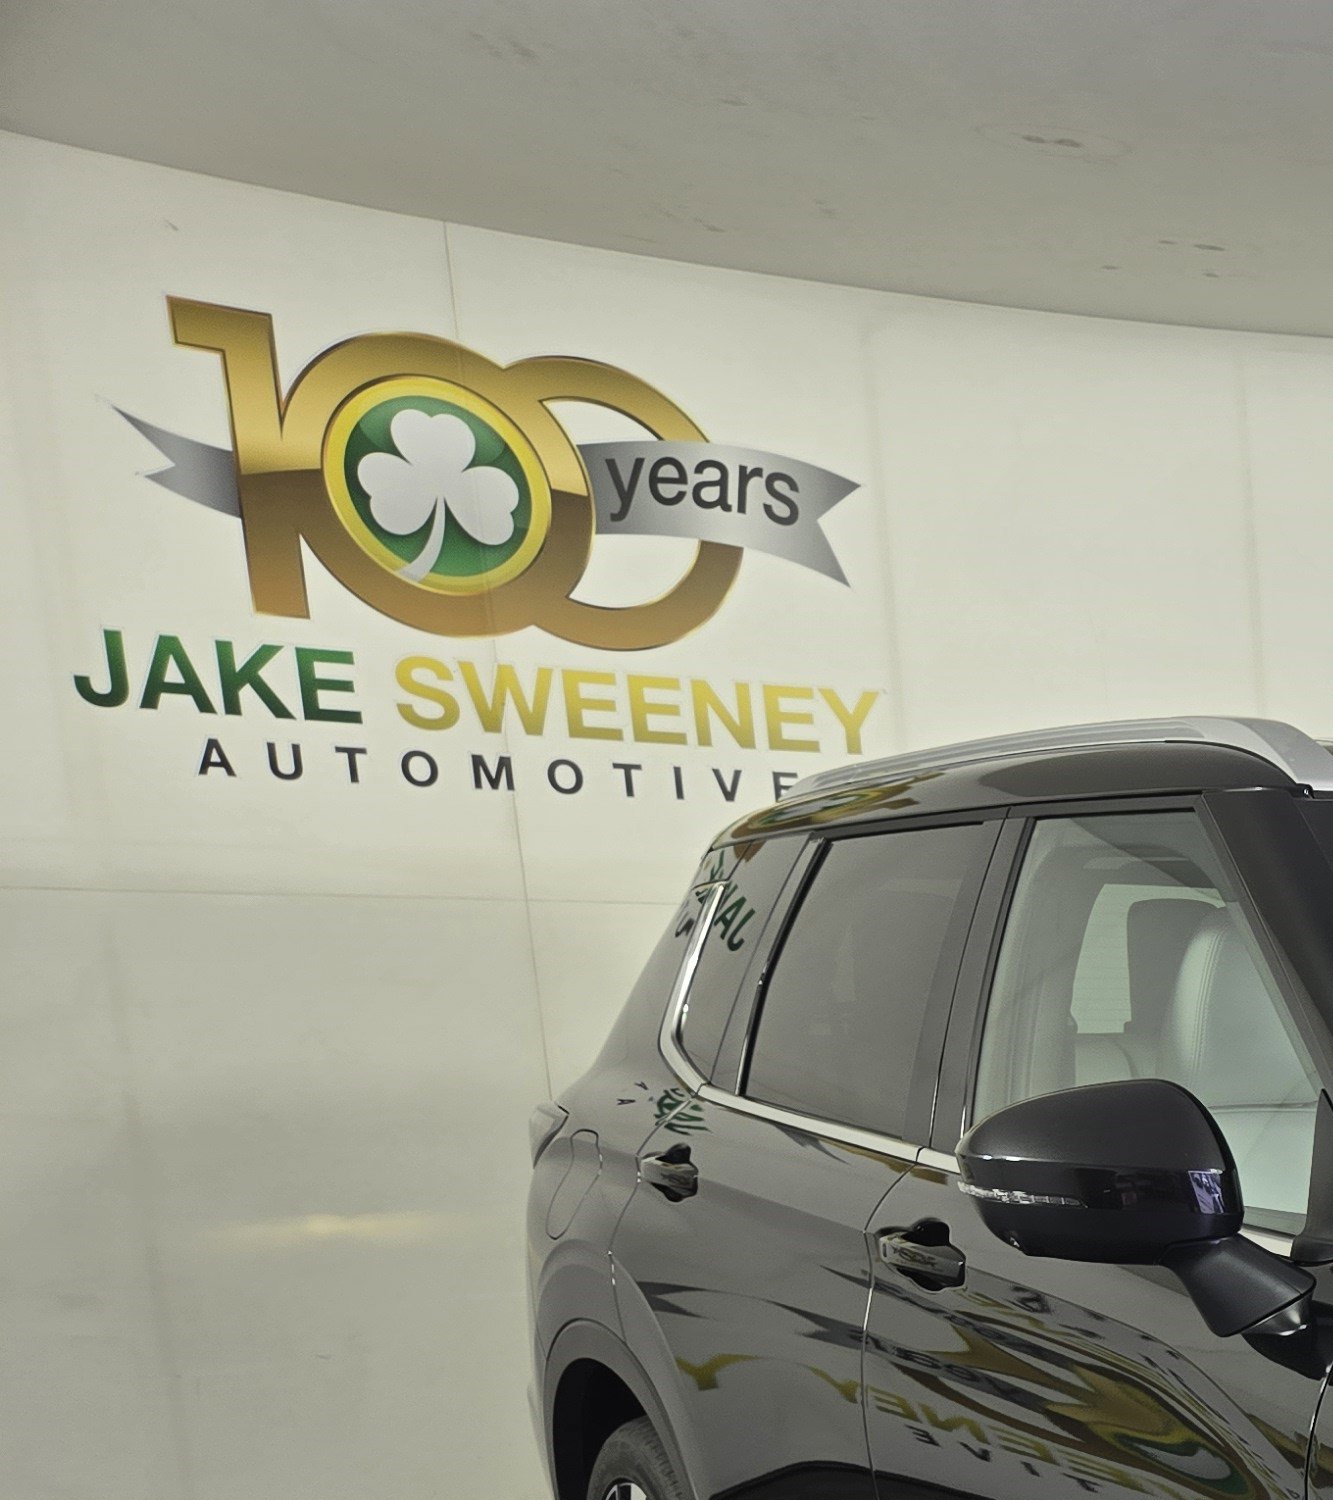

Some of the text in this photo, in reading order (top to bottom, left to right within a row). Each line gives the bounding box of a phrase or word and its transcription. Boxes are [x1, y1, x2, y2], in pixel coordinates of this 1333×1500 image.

[605, 456, 800, 527] years
[73, 629, 880, 755] JAKE SWEENEY
[198, 738, 799, 802] AUTOMOTIVE
